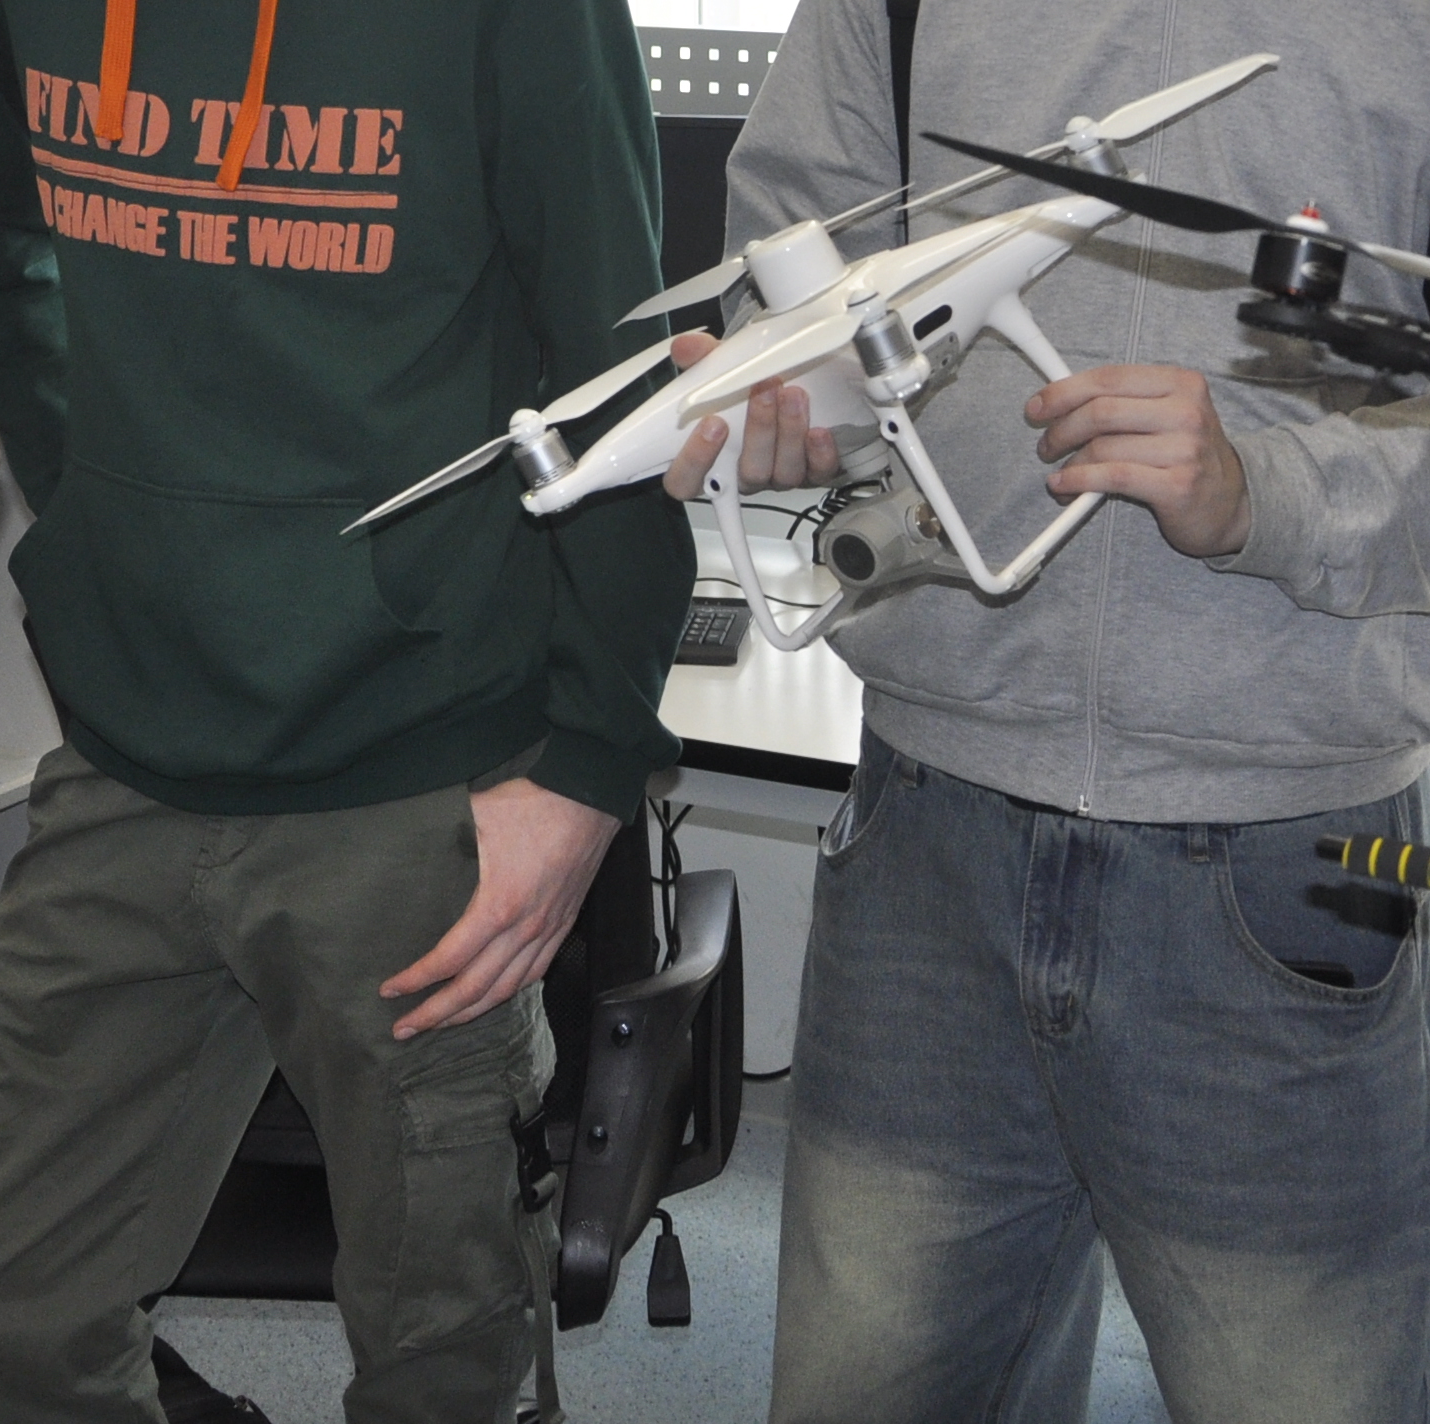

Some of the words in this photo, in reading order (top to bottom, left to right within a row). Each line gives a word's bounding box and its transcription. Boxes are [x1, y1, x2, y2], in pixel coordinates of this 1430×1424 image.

[53, 185, 168, 258] CHANGE
[177, 210, 238, 265] THE
[247, 216, 394, 274] WORLD
